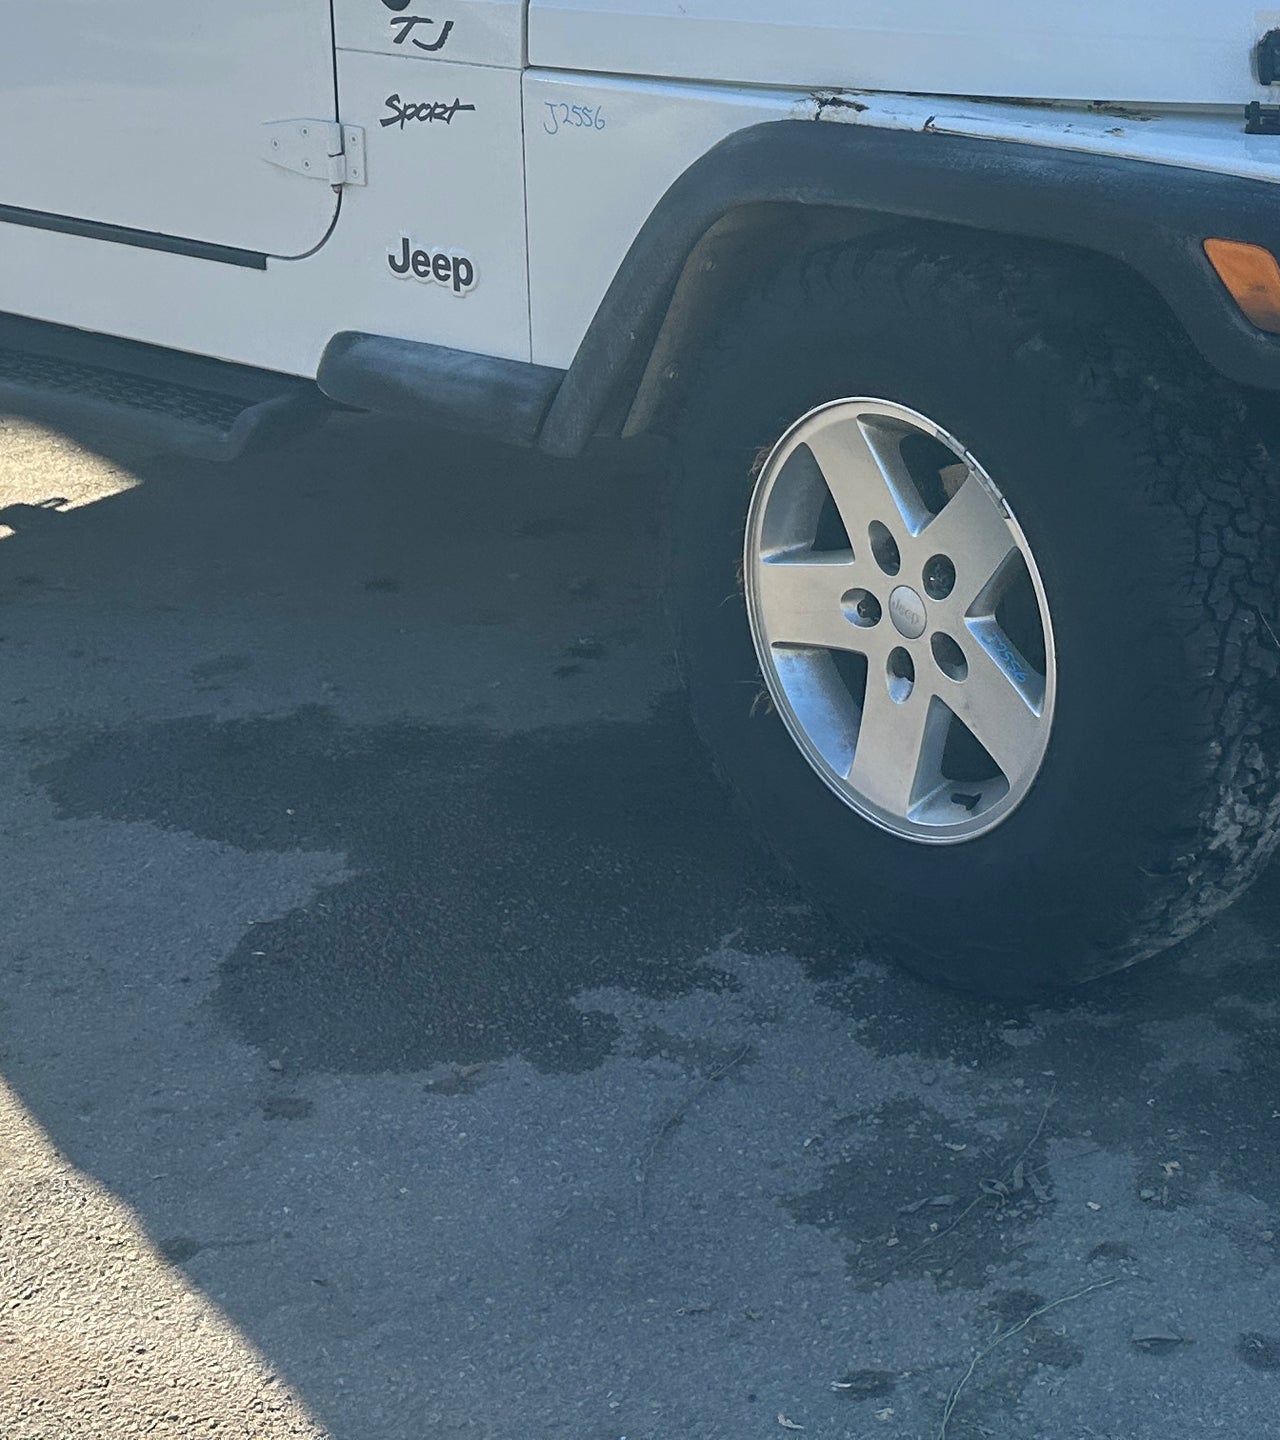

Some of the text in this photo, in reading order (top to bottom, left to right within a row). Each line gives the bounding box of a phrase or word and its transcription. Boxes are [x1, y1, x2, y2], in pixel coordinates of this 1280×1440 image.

[390, 15, 455, 51] TJ
[379, 93, 477, 129] Sport
[543, 101, 606, 135] J2556
[387, 237, 474, 292] Jeep
